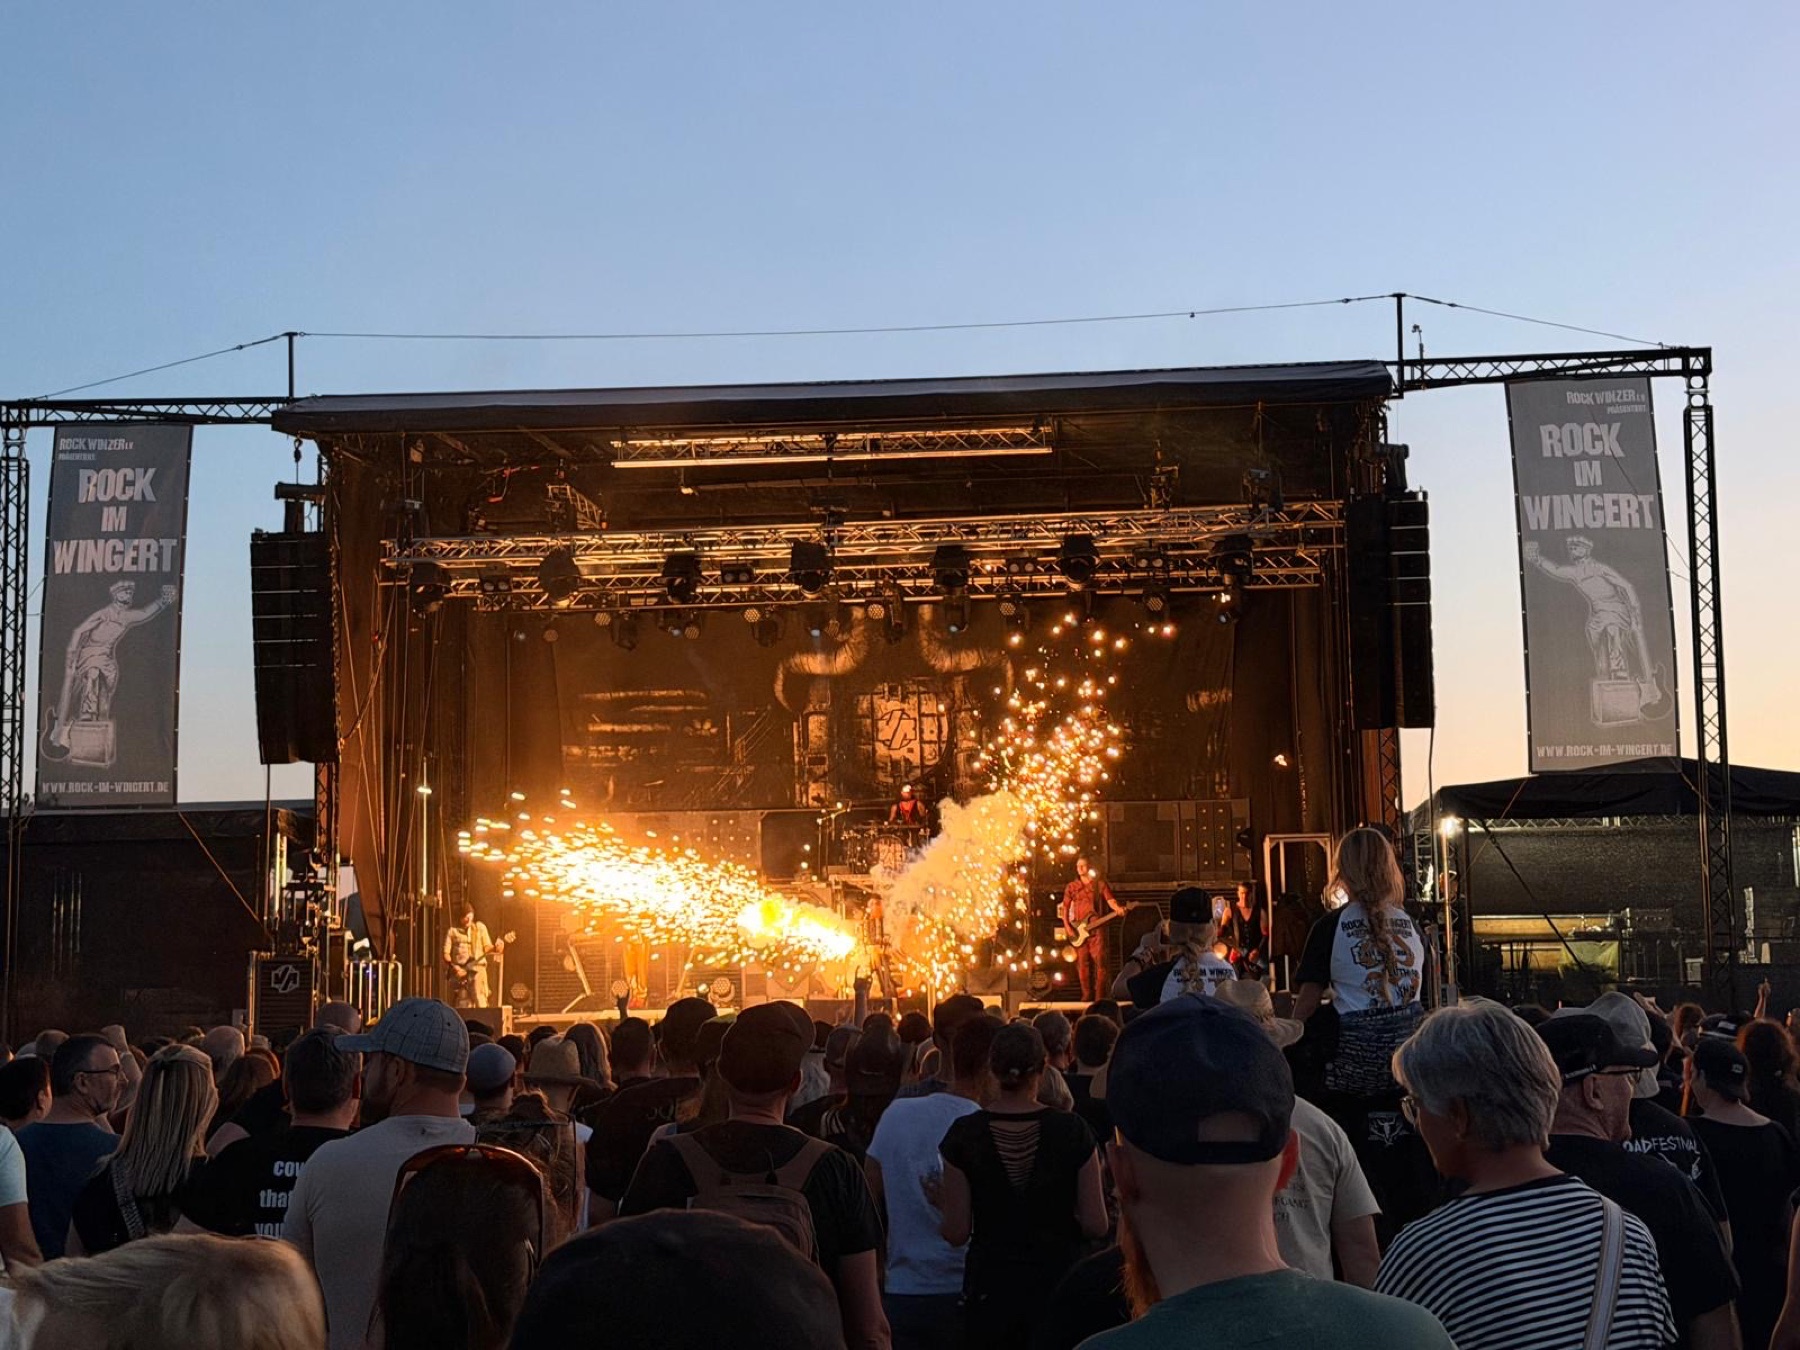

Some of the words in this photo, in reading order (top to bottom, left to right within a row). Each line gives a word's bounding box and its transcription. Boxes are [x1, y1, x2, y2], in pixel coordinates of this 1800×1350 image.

[1566, 391, 1594, 405] ROCK
[1595, 389, 1636, 405] WINZER
[59, 438, 86, 450] ROCK
[1539, 422, 1626, 458] ROCK
[78, 467, 157, 503] ROCK
[1573, 460, 1603, 487] IM
[101, 506, 127, 532] IM
[1522, 493, 1655, 530] WINGERT
[53, 538, 178, 574] WINGERT
